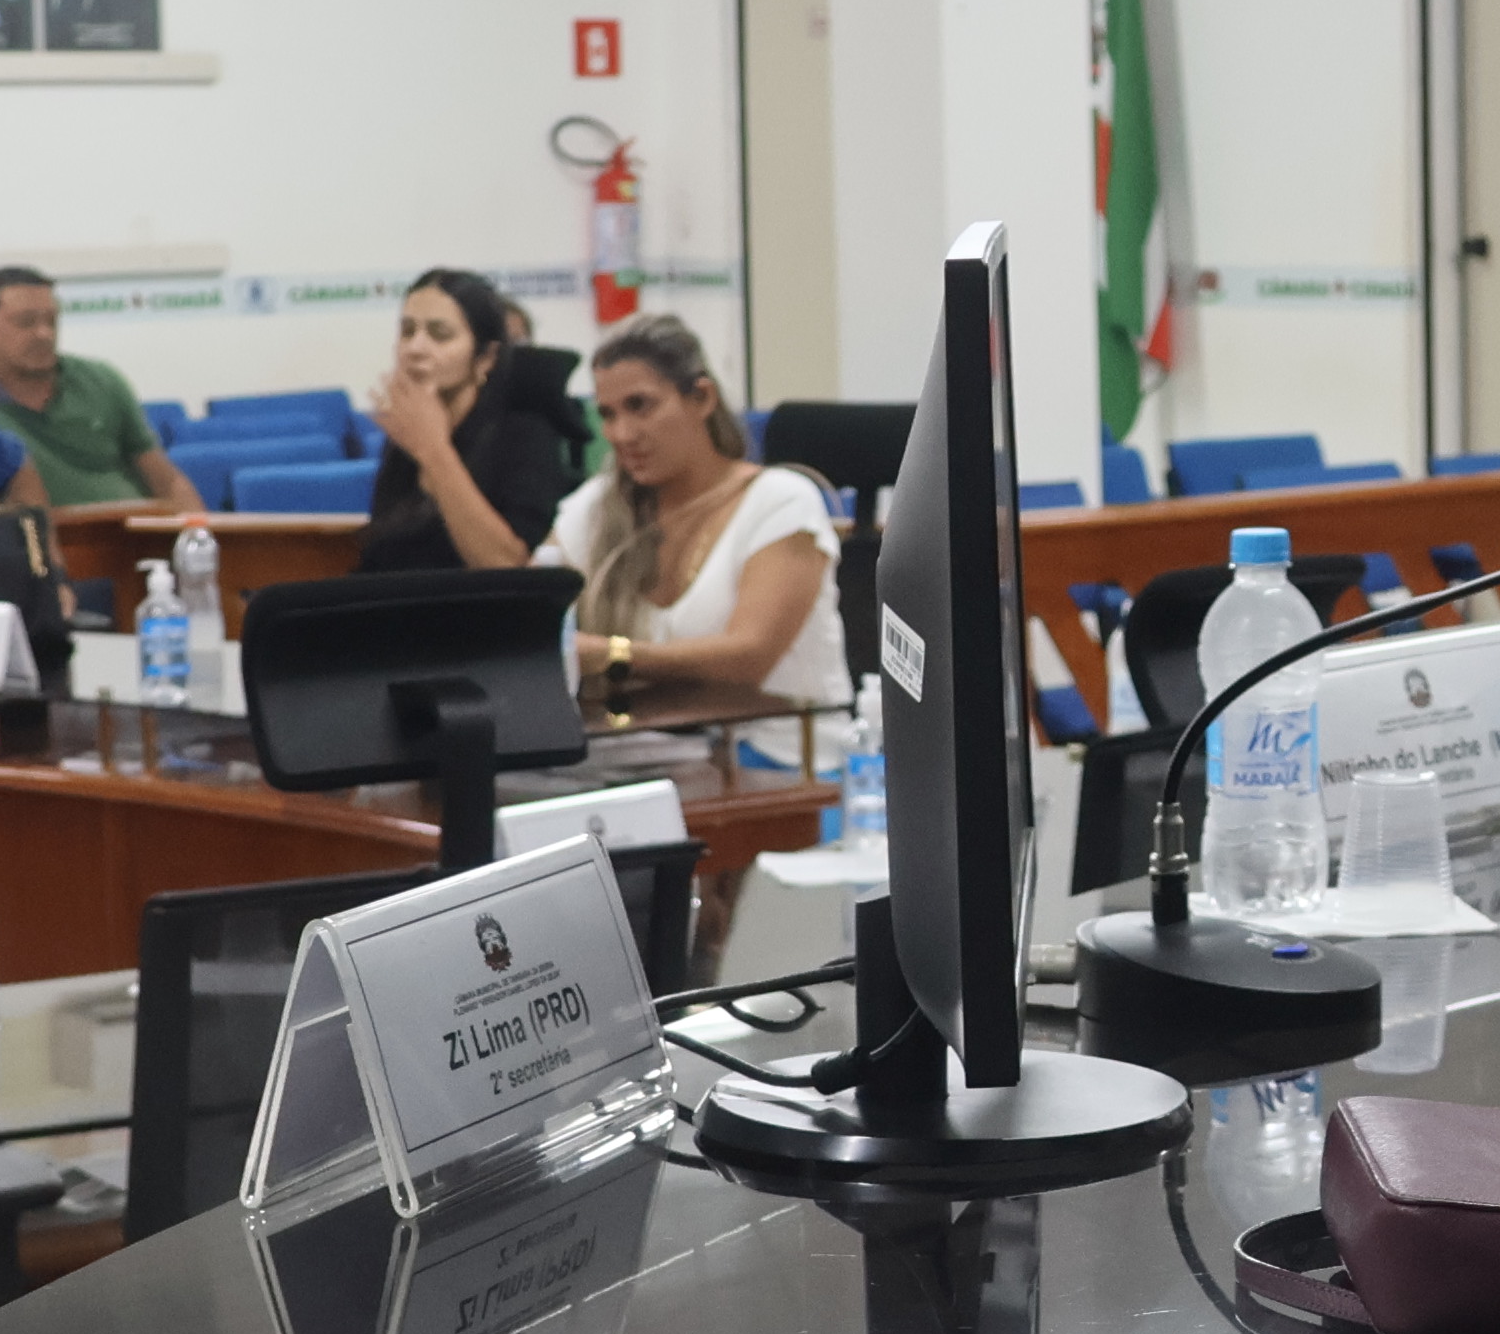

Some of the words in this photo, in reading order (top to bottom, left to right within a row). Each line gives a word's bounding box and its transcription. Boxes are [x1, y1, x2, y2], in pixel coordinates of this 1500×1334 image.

[1420, 737, 1481, 766] Lanche
[443, 1029, 470, 1071] Zi
[470, 1016, 528, 1060] Lima
[528, 983, 590, 1045] (PRD)
